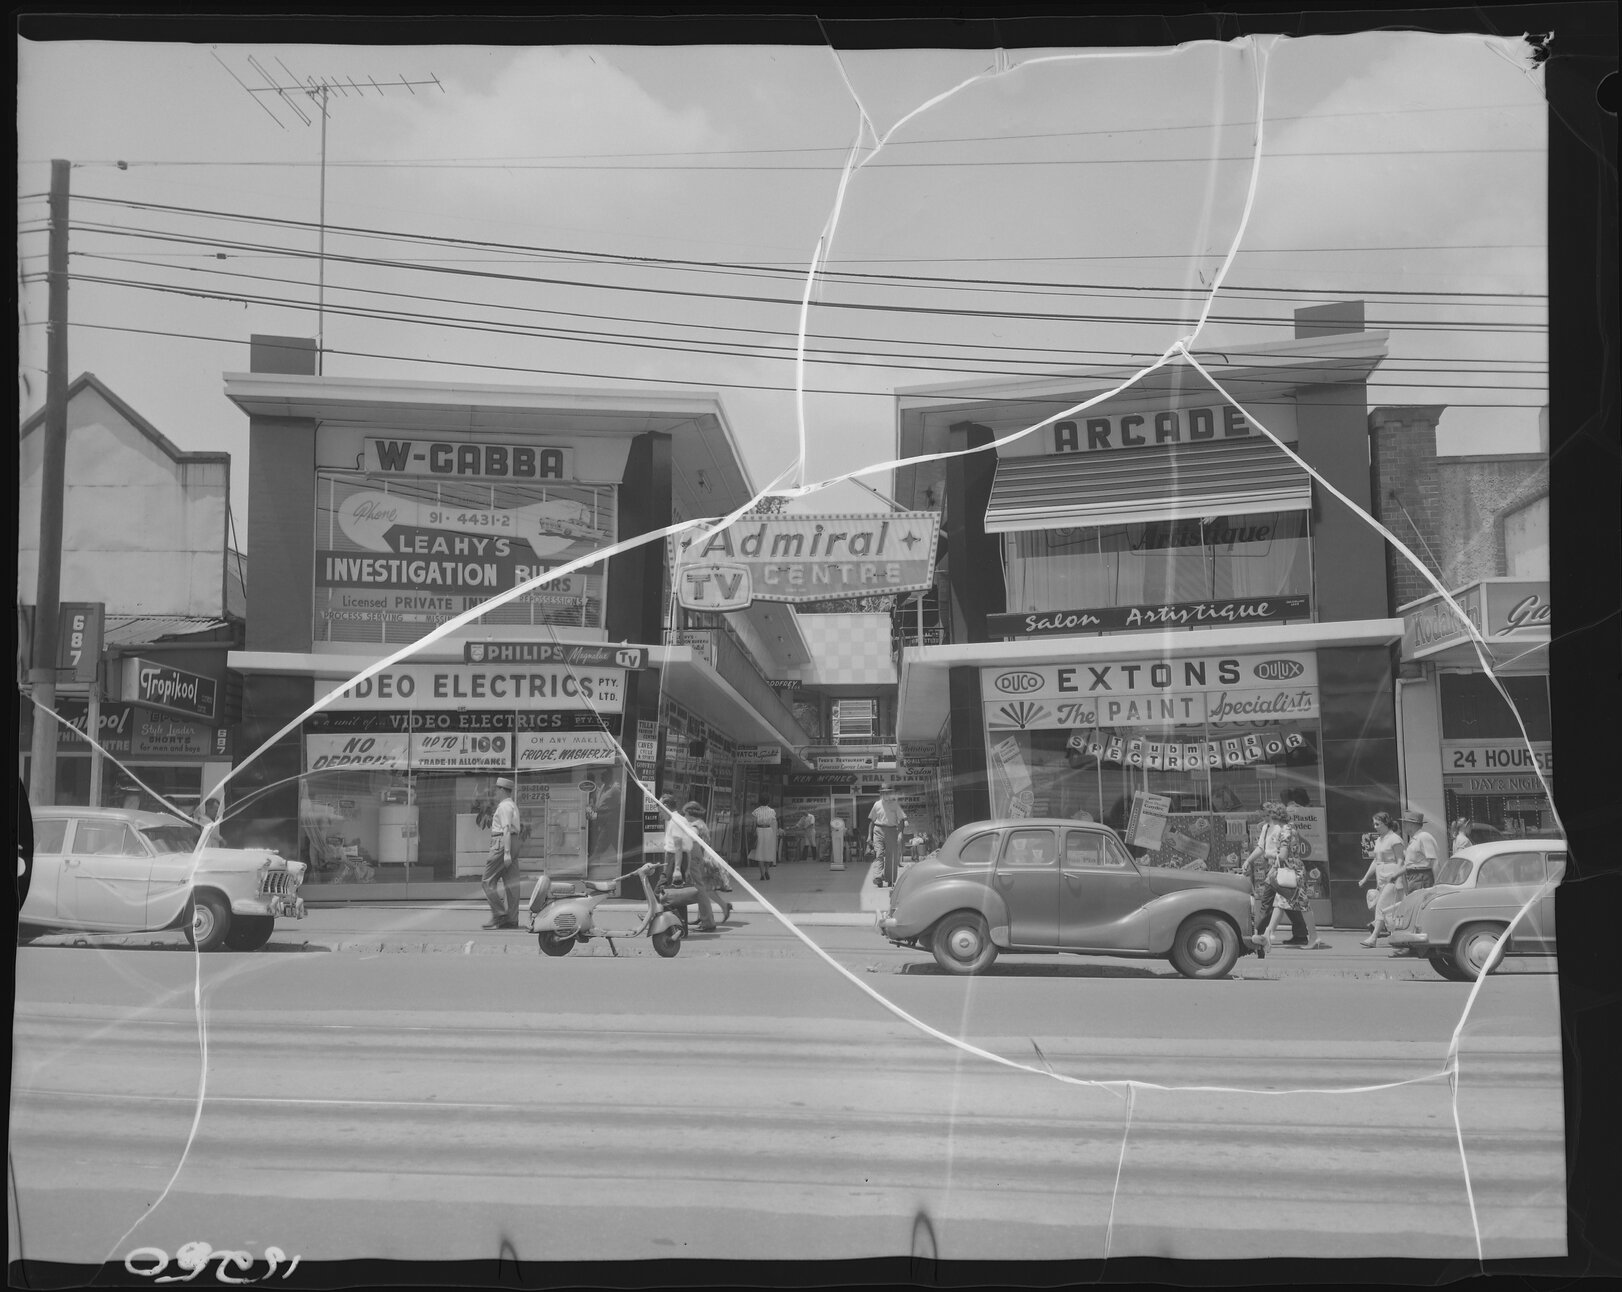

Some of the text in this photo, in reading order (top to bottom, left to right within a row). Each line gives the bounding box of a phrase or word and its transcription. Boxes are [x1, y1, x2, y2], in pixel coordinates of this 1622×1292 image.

[1054, 405, 1250, 452] ARCADE
[375, 440, 564, 479] W-GABBA
[353, 500, 398, 527] Phone
[399, 535, 511, 557] LEAHY'S
[700, 521, 891, 558] Admiral
[326, 557, 497, 587] INVESTIGATION
[763, 563, 901, 585] CENTRE
[686, 573, 743, 600] TV
[342, 595, 387, 608] Licensed
[395, 596, 453, 610] PRIVATE
[324, 611, 454, 623] PROCESS SERVING MISSIN
[1025, 601, 1277, 633] Salon Artistique
[70, 615, 85, 666] 687
[487, 645, 563, 661] PHILIPS
[619, 651, 638, 667] TV
[140, 668, 199, 705] Tropikool
[343, 674, 618, 699] DEO ELECTRICS PTY.
[1057, 659, 1241, 693] EXTONS
[598, 692, 618, 702] LTD.
[1056, 691, 1313, 725] The PAINT Specialists
[141, 724, 163, 737] Style
[390, 714, 450, 729] VIDEO
[459, 714, 563, 729] ELECTRICS
[343, 737, 376, 754] NO
[421, 736, 440, 748] UP
[440, 736, 459, 749] TO
[531, 736, 544, 744] ON
[549, 736, 570, 744] ANY
[1069, 733, 1304, 767] SPECTROCOLOR
[1112, 736, 1256, 753] Taubmans
[418, 757, 507, 766] TRADE-IN ALLOWANCE
[1453, 750, 1477, 772] 24
[862, 774, 885, 782] REAL
[1469, 776, 1541, 792] DAY & NIGH
